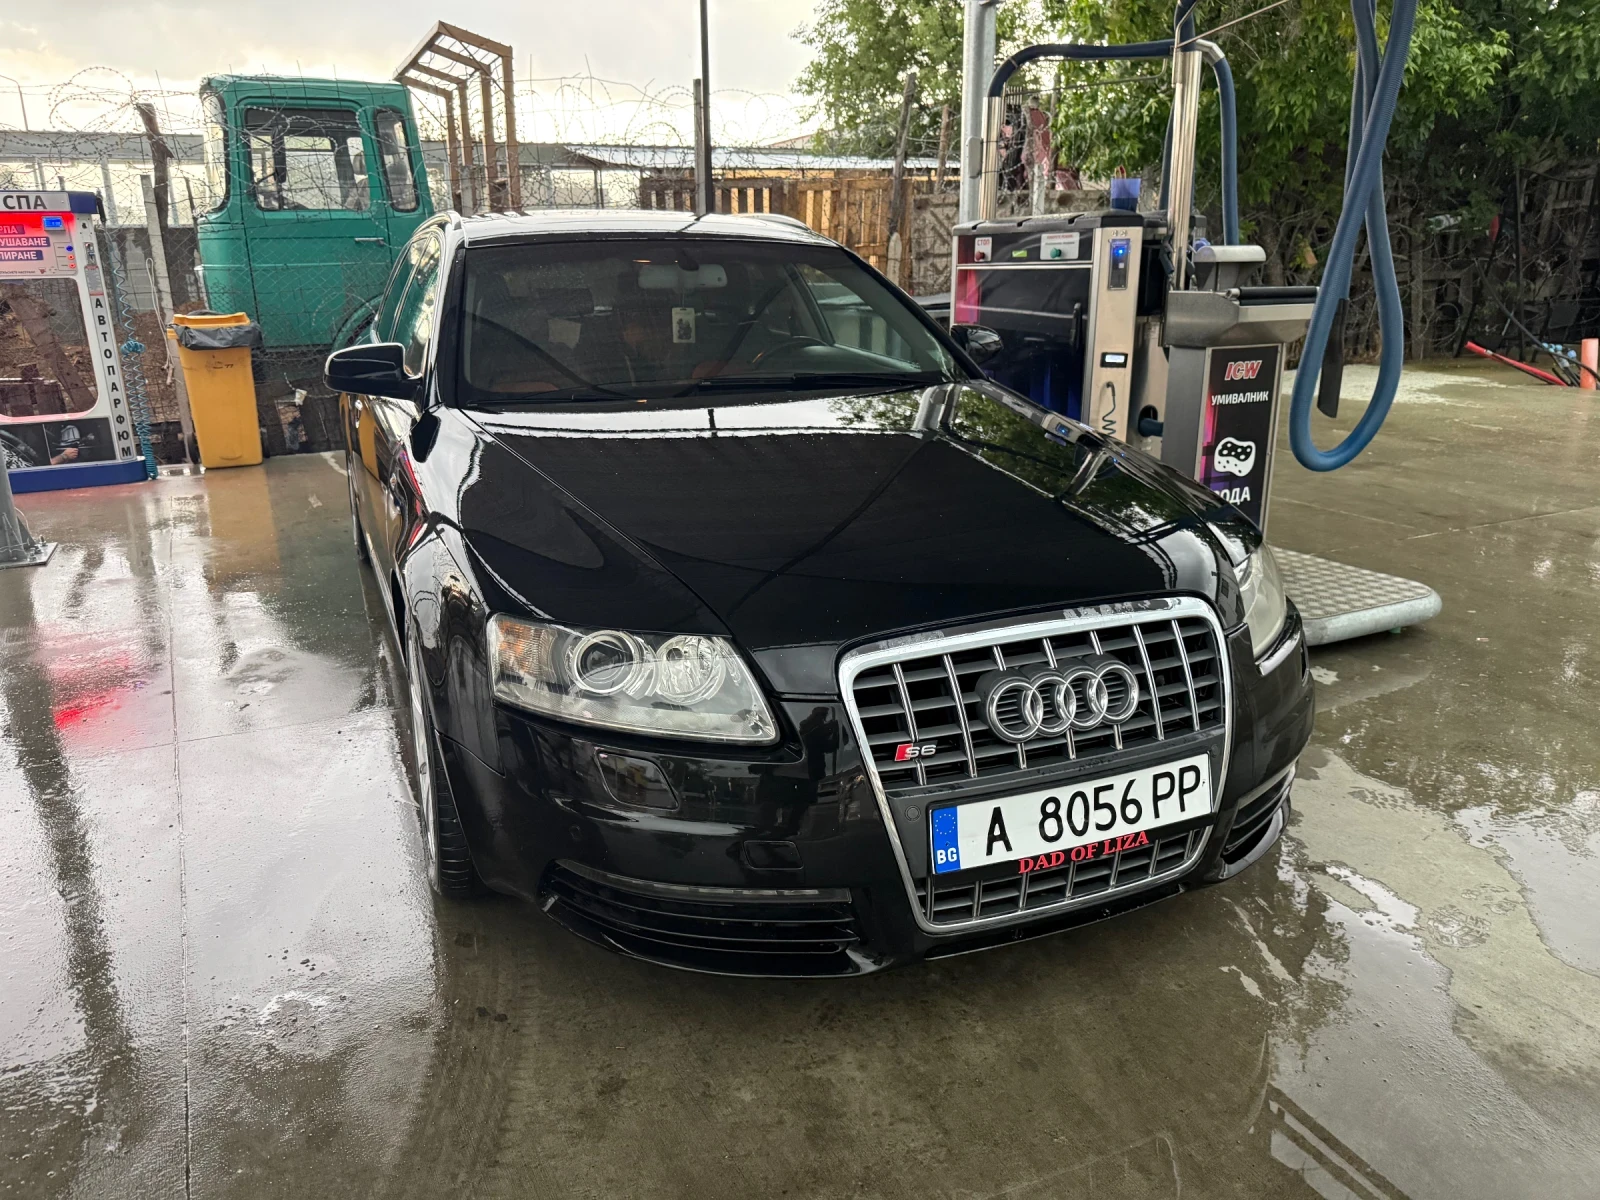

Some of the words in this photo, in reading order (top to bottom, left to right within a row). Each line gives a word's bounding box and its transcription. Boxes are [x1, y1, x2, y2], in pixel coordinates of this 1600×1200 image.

[2, 194, 48, 210] СПА
[1224, 360, 1262, 381] ICW
[1211, 391, 1269, 406] УМИВАЛНИК
[1213, 486, 1251, 505] ОДА
[904, 744, 937, 758] S6
[985, 806, 1013, 857] A
[1038, 779, 1143, 843] 8056
[1151, 764, 1201, 820] PP
[936, 847, 958, 865] BG
[1017, 851, 1065, 875] DAD
[1070, 845, 1099, 861] OF
[1103, 830, 1150, 855] LIZA
